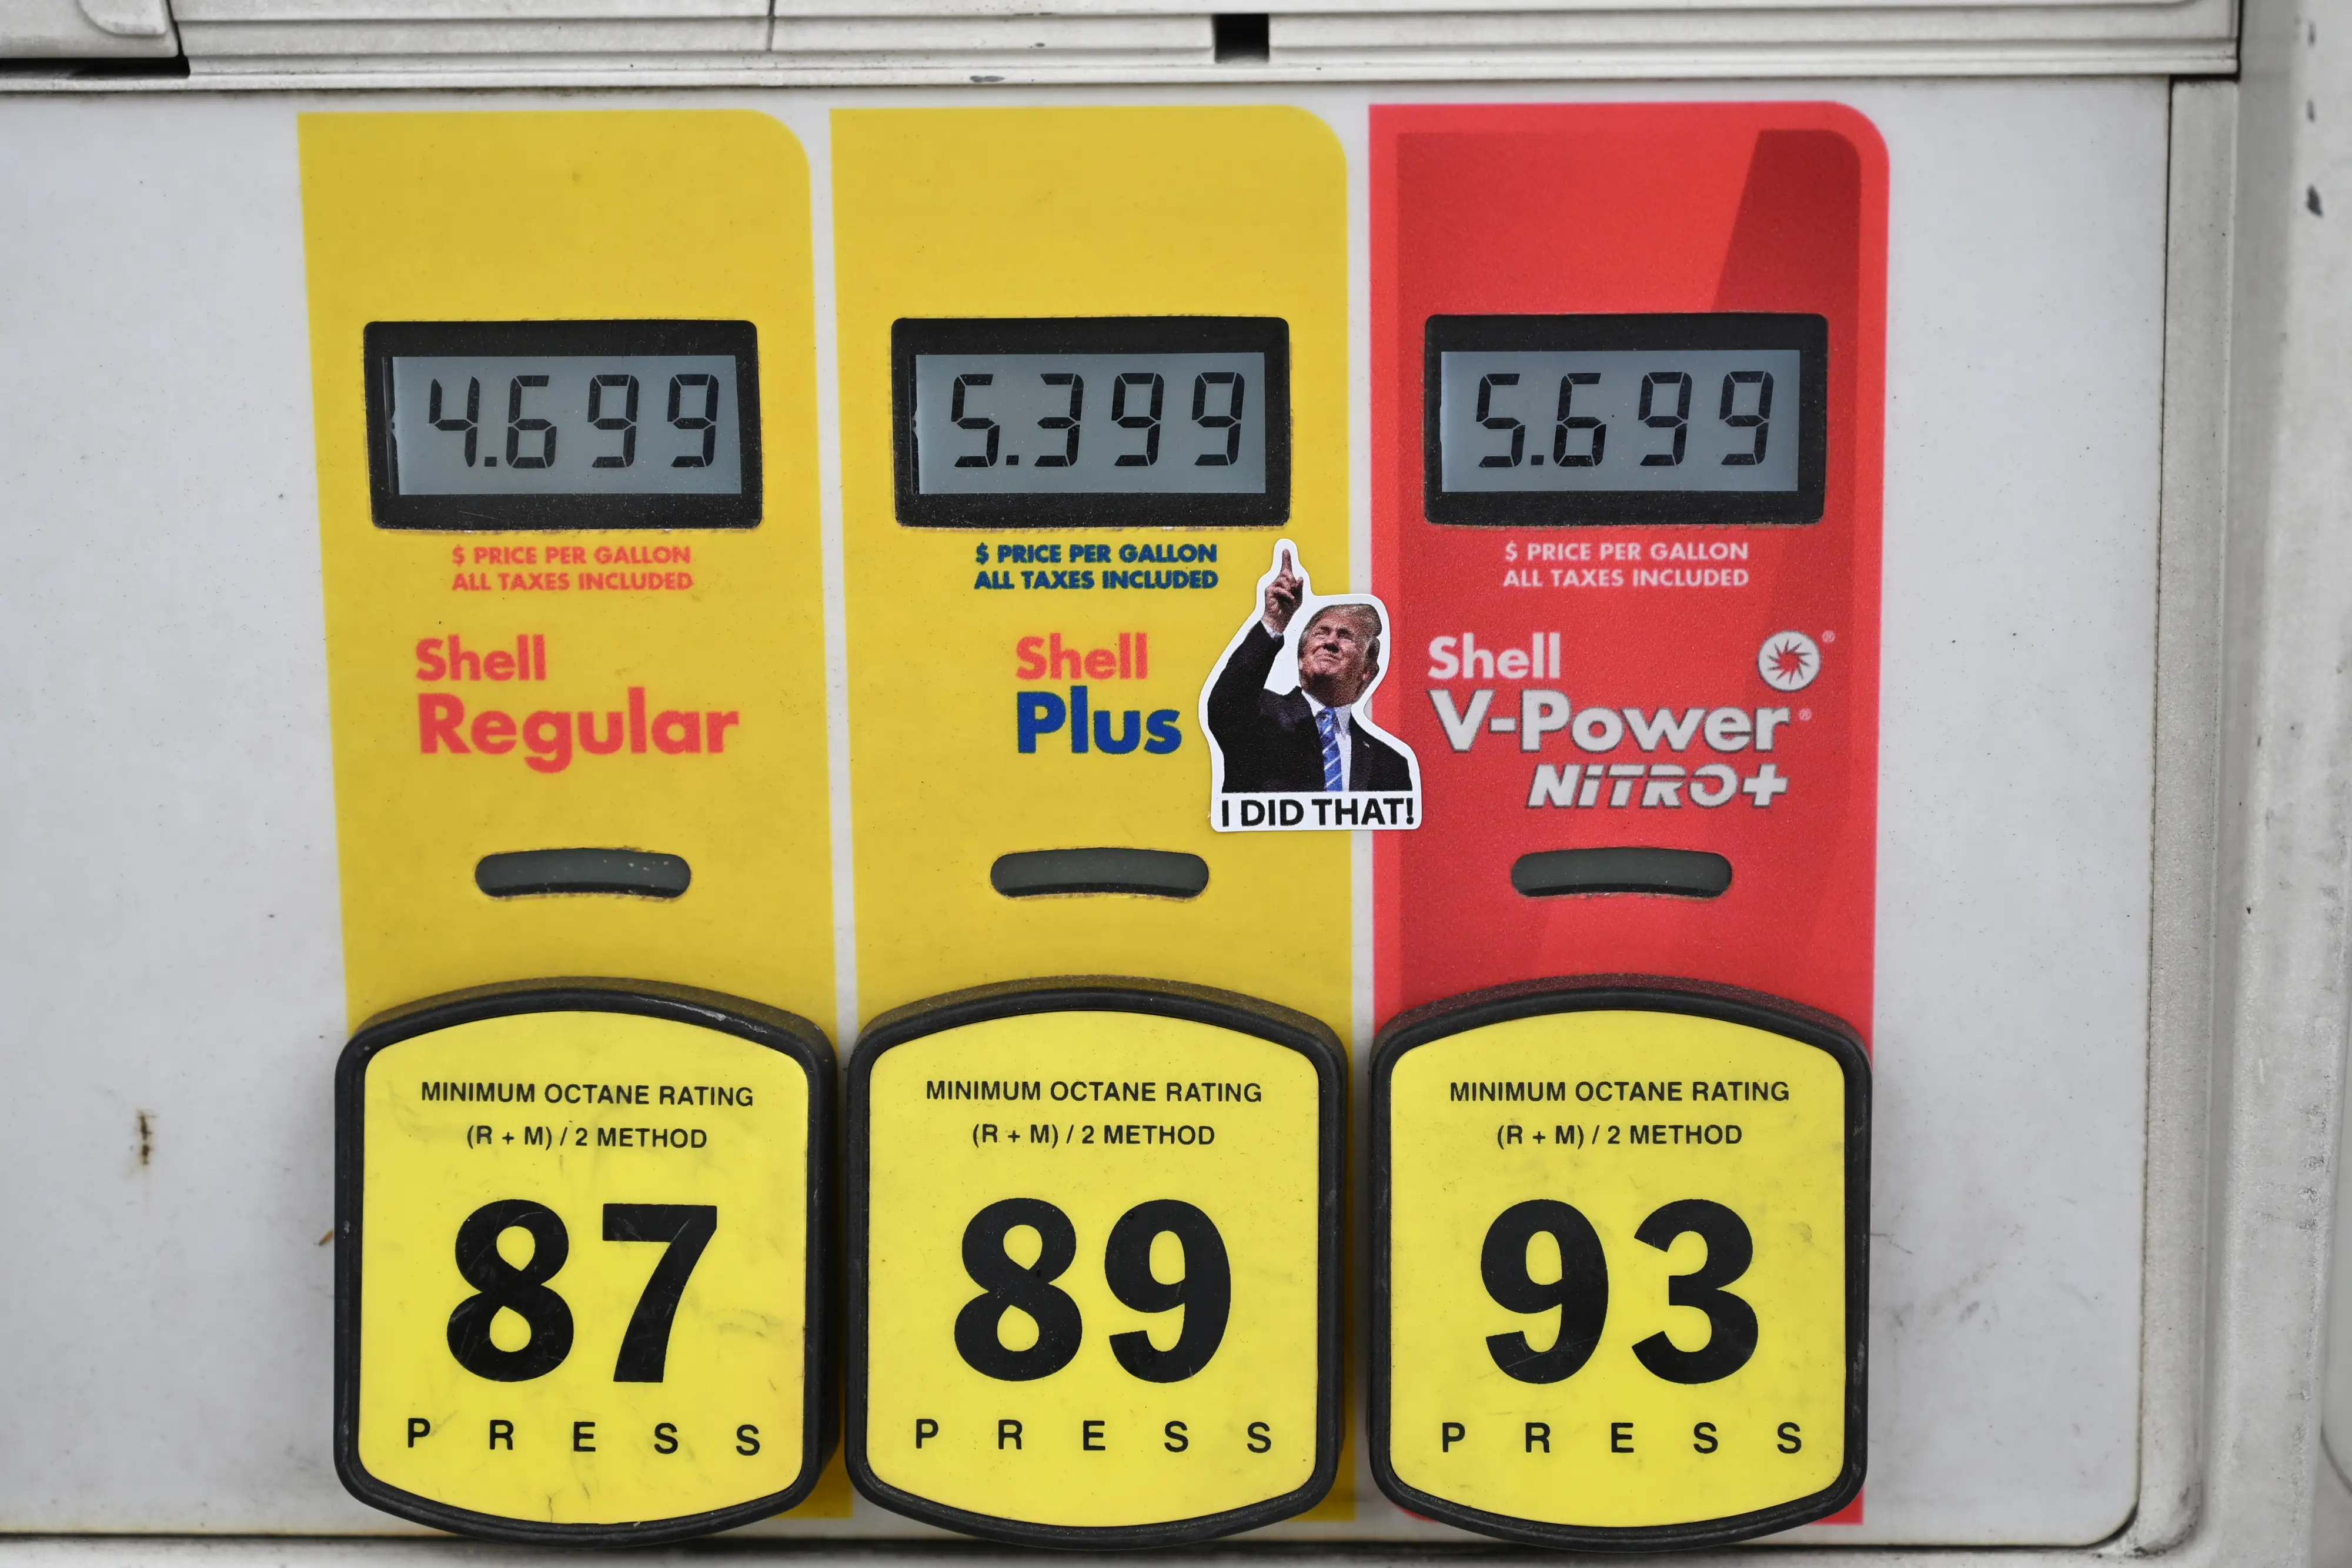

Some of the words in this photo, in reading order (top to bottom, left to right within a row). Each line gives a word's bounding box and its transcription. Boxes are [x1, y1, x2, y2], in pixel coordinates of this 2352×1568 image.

[429, 373, 719, 469] 4.699
[951, 372, 1245, 468] 5.399
[1476, 370, 1774, 468] 5.699
[452, 544, 466, 567] $
[473, 546, 537, 565] PRICE
[545, 546, 587, 565] PER
[593, 546, 691, 565] GALLON
[975, 542, 990, 565] $
[997, 544, 1062, 564] PRICE
[1069, 544, 1112, 563] PER
[1118, 543, 1217, 564] GALLON
[1505, 540, 1518, 563] $
[1528, 543, 1591, 561] PRICE
[1600, 542, 1641, 561] PER
[1649, 542, 1748, 561] GALLON
[452, 572, 492, 591] ALL
[498, 572, 571, 591] TAXES
[577, 571, 694, 591] INCLUDED
[974, 570, 1015, 590] ALL
[1022, 570, 1095, 590] TAXES
[1102, 569, 1219, 590] INCLUDED
[1503, 569, 1543, 587] ALL
[1551, 569, 1624, 587] TAXES
[1632, 569, 1749, 587] INCLUDED
[415, 634, 546, 682] Shell
[1015, 632, 1148, 681] Shell
[1428, 632, 1561, 680] Shell
[417, 686, 740, 774] Regular
[1017, 685, 1182, 755] Plus
[1426, 688, 1791, 754] V-Power
[1221, 800, 1230, 827] I
[1240, 799, 1304, 827] DID
[1311, 797, 1414, 826] THAT!
[422, 1081, 535, 1103] MINIMUM
[544, 1083, 650, 1105] OCTANE
[659, 1085, 753, 1107] RATING
[926, 1080, 1041, 1101] MINIMUM
[1050, 1081, 1156, 1102] OCTANE
[1166, 1082, 1261, 1102] RATING
[1450, 1081, 1566, 1102] MINIMUM
[1575, 1081, 1683, 1102] OCTANE
[1692, 1081, 1789, 1102] RATING
[575, 1127, 588, 1146] 2
[597, 1127, 707, 1148] METHOD
[1081, 1125, 1094, 1144] 2
[1104, 1125, 1215, 1145] METHOD
[1607, 1125, 1621, 1145] 2
[1630, 1124, 1742, 1145] METHOD
[446, 1199, 717, 1383] 87
[954, 1197, 1231, 1383] 89
[1480, 1198, 1759, 1385] 93
